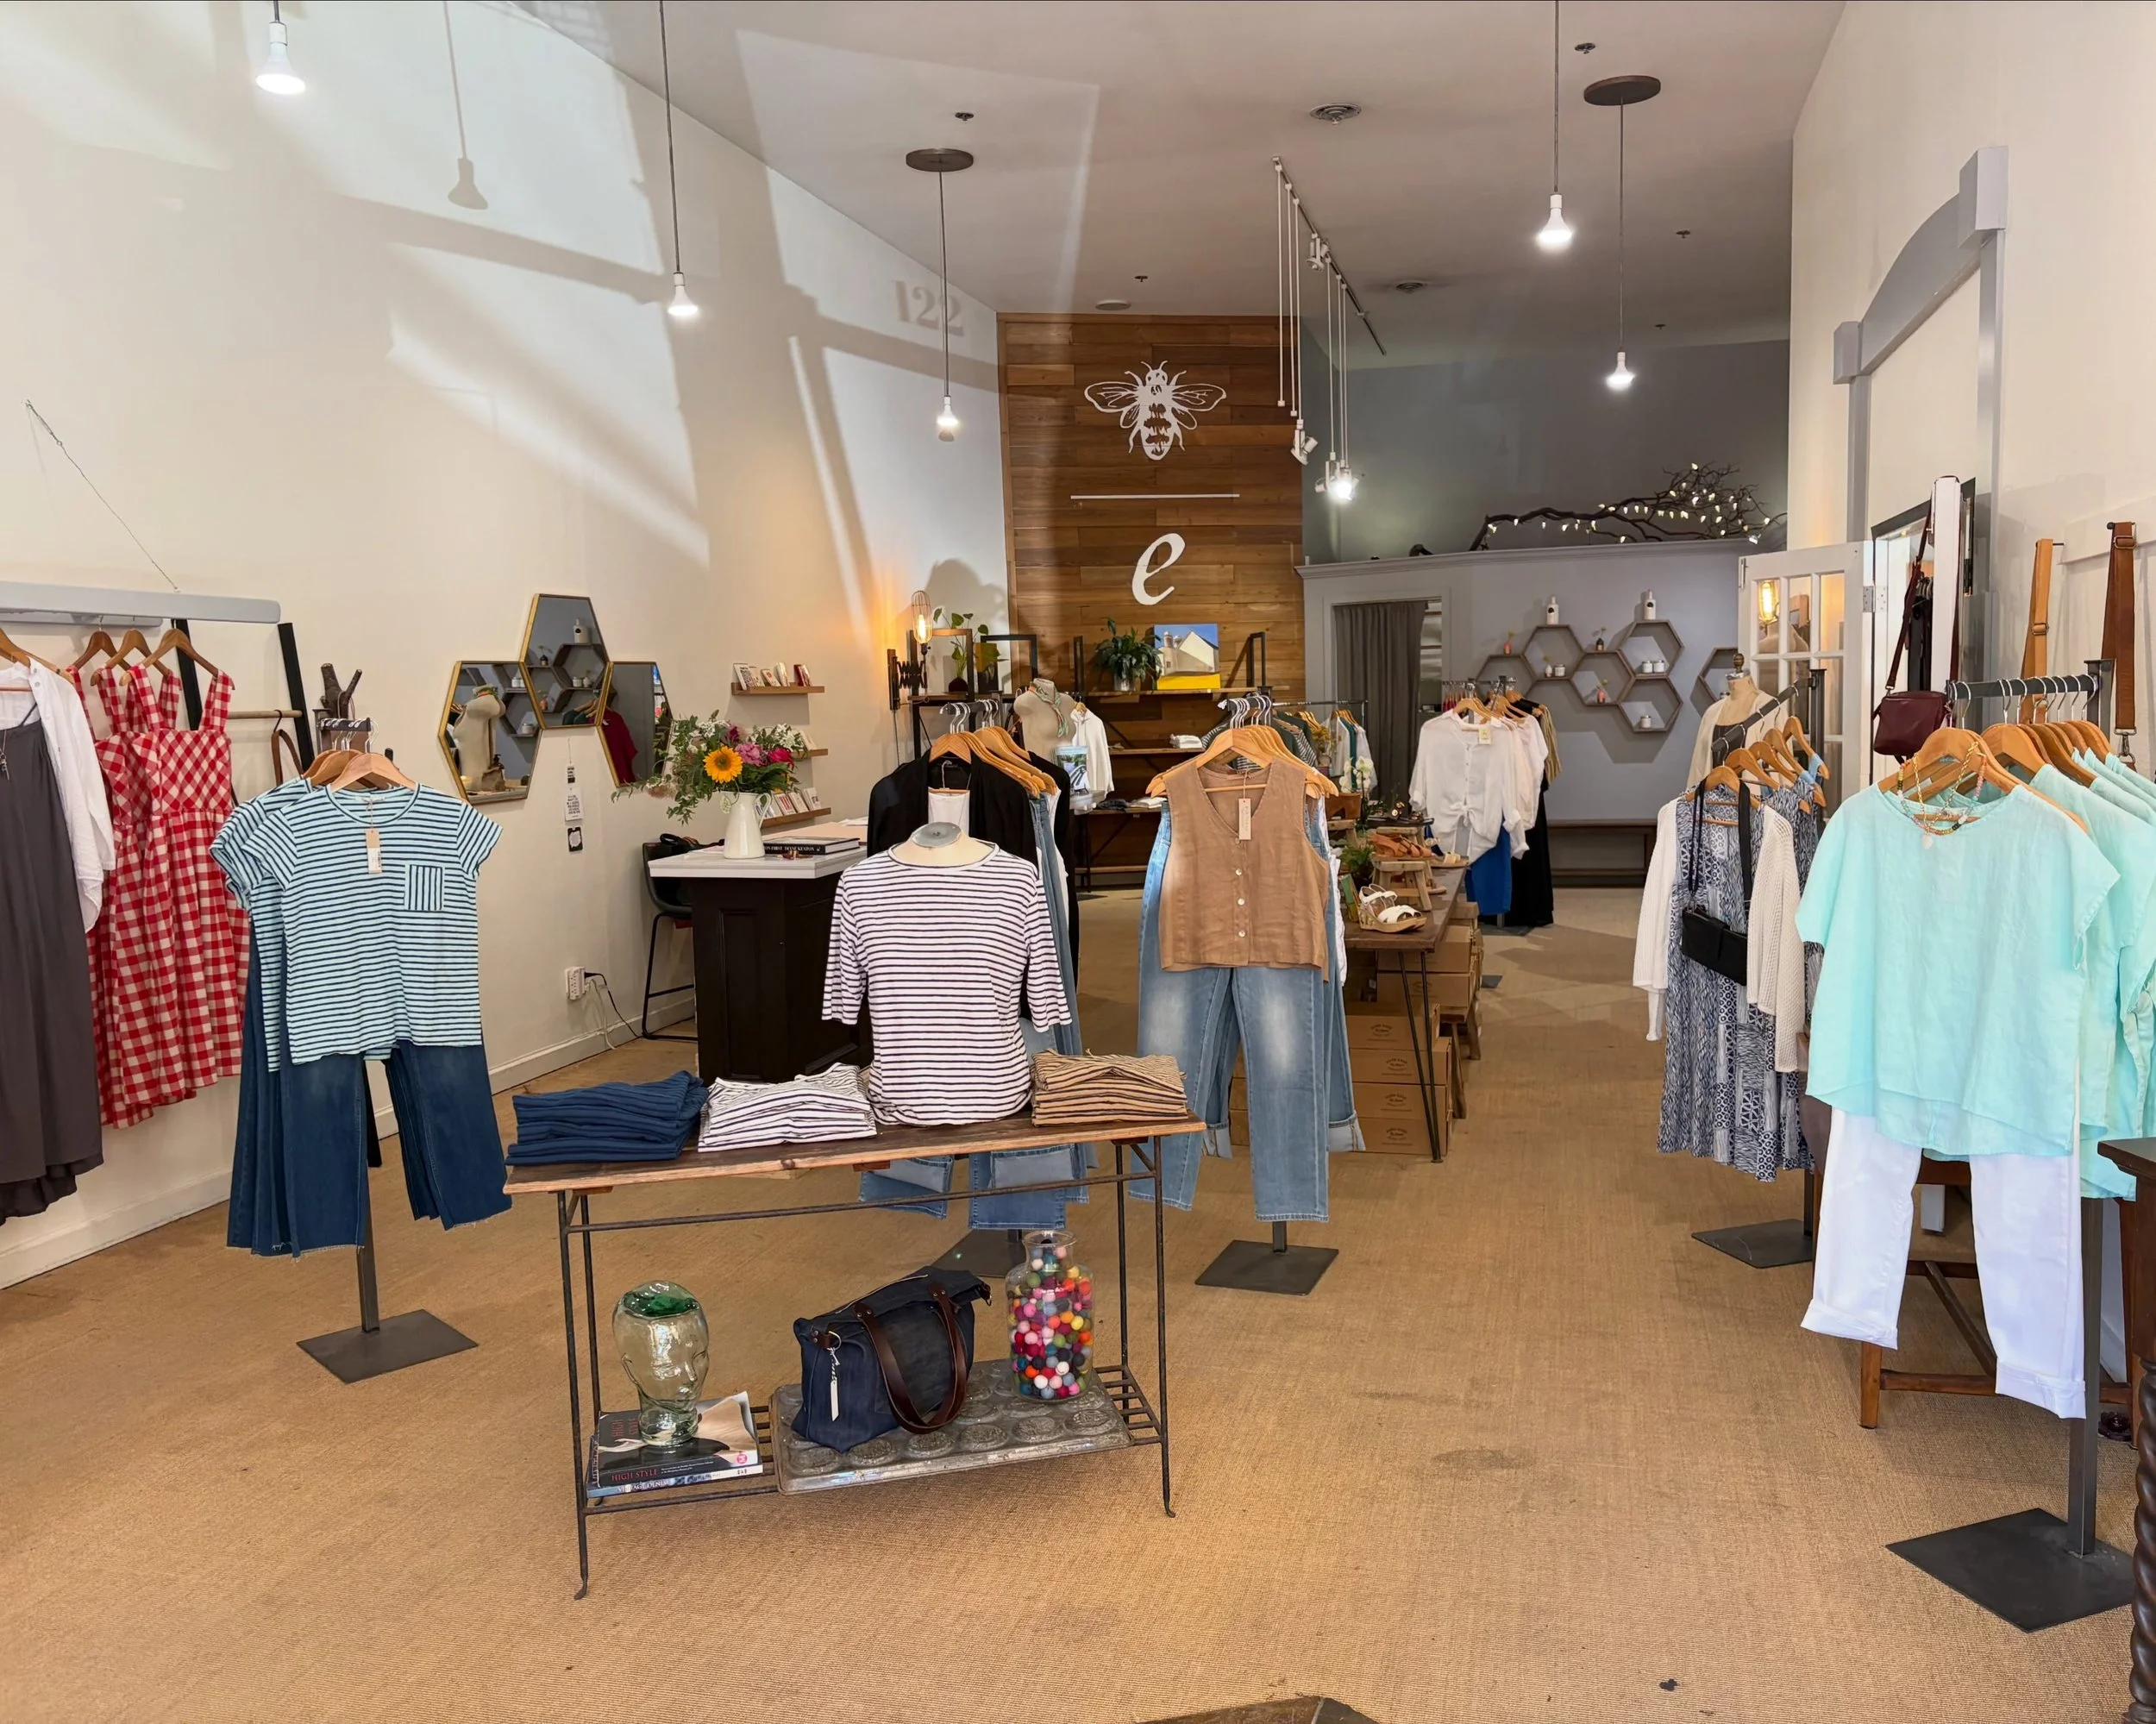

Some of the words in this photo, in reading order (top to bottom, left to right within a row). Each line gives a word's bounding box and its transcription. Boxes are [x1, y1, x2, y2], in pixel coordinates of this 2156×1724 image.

[891, 280, 964, 336] 122
[1131, 532, 1186, 605] e
[611, 1473, 633, 1482] HIGH
[636, 1469, 658, 1477] STYLE
[617, 1482, 646, 1493] VITAGE
[647, 1479, 670, 1488] DENIM
